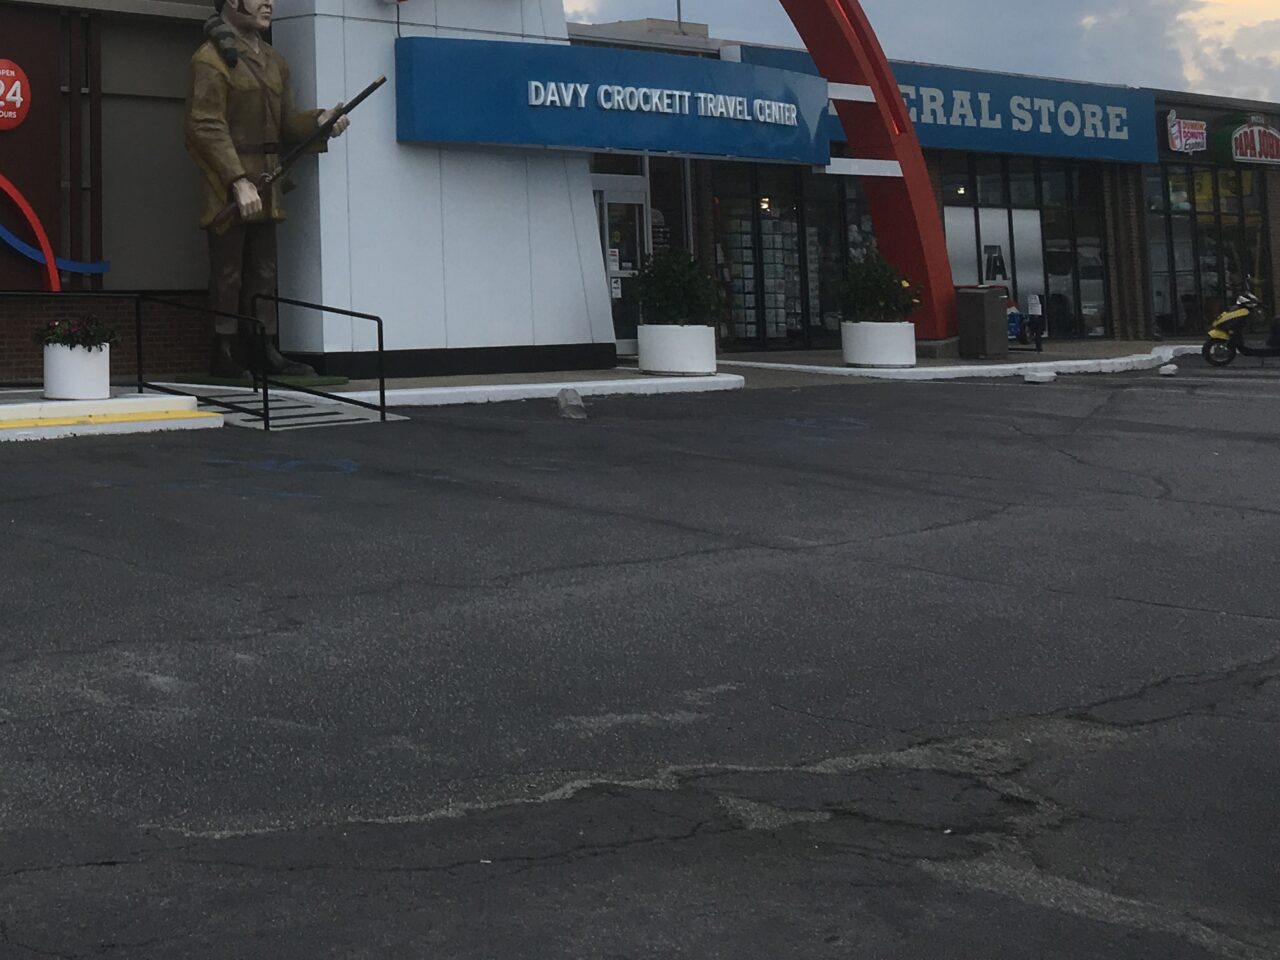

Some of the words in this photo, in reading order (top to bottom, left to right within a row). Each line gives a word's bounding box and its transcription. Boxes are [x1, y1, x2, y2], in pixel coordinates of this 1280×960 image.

[527, 80, 589, 109] DAVY
[596, 84, 692, 115] CROCKETT
[694, 92, 752, 121] TRAVEL
[752, 98, 798, 126] CENTER
[1009, 95, 1129, 140] STORE
[1234, 129, 1257, 157] PAPA
[983, 245, 1008, 281] TA
